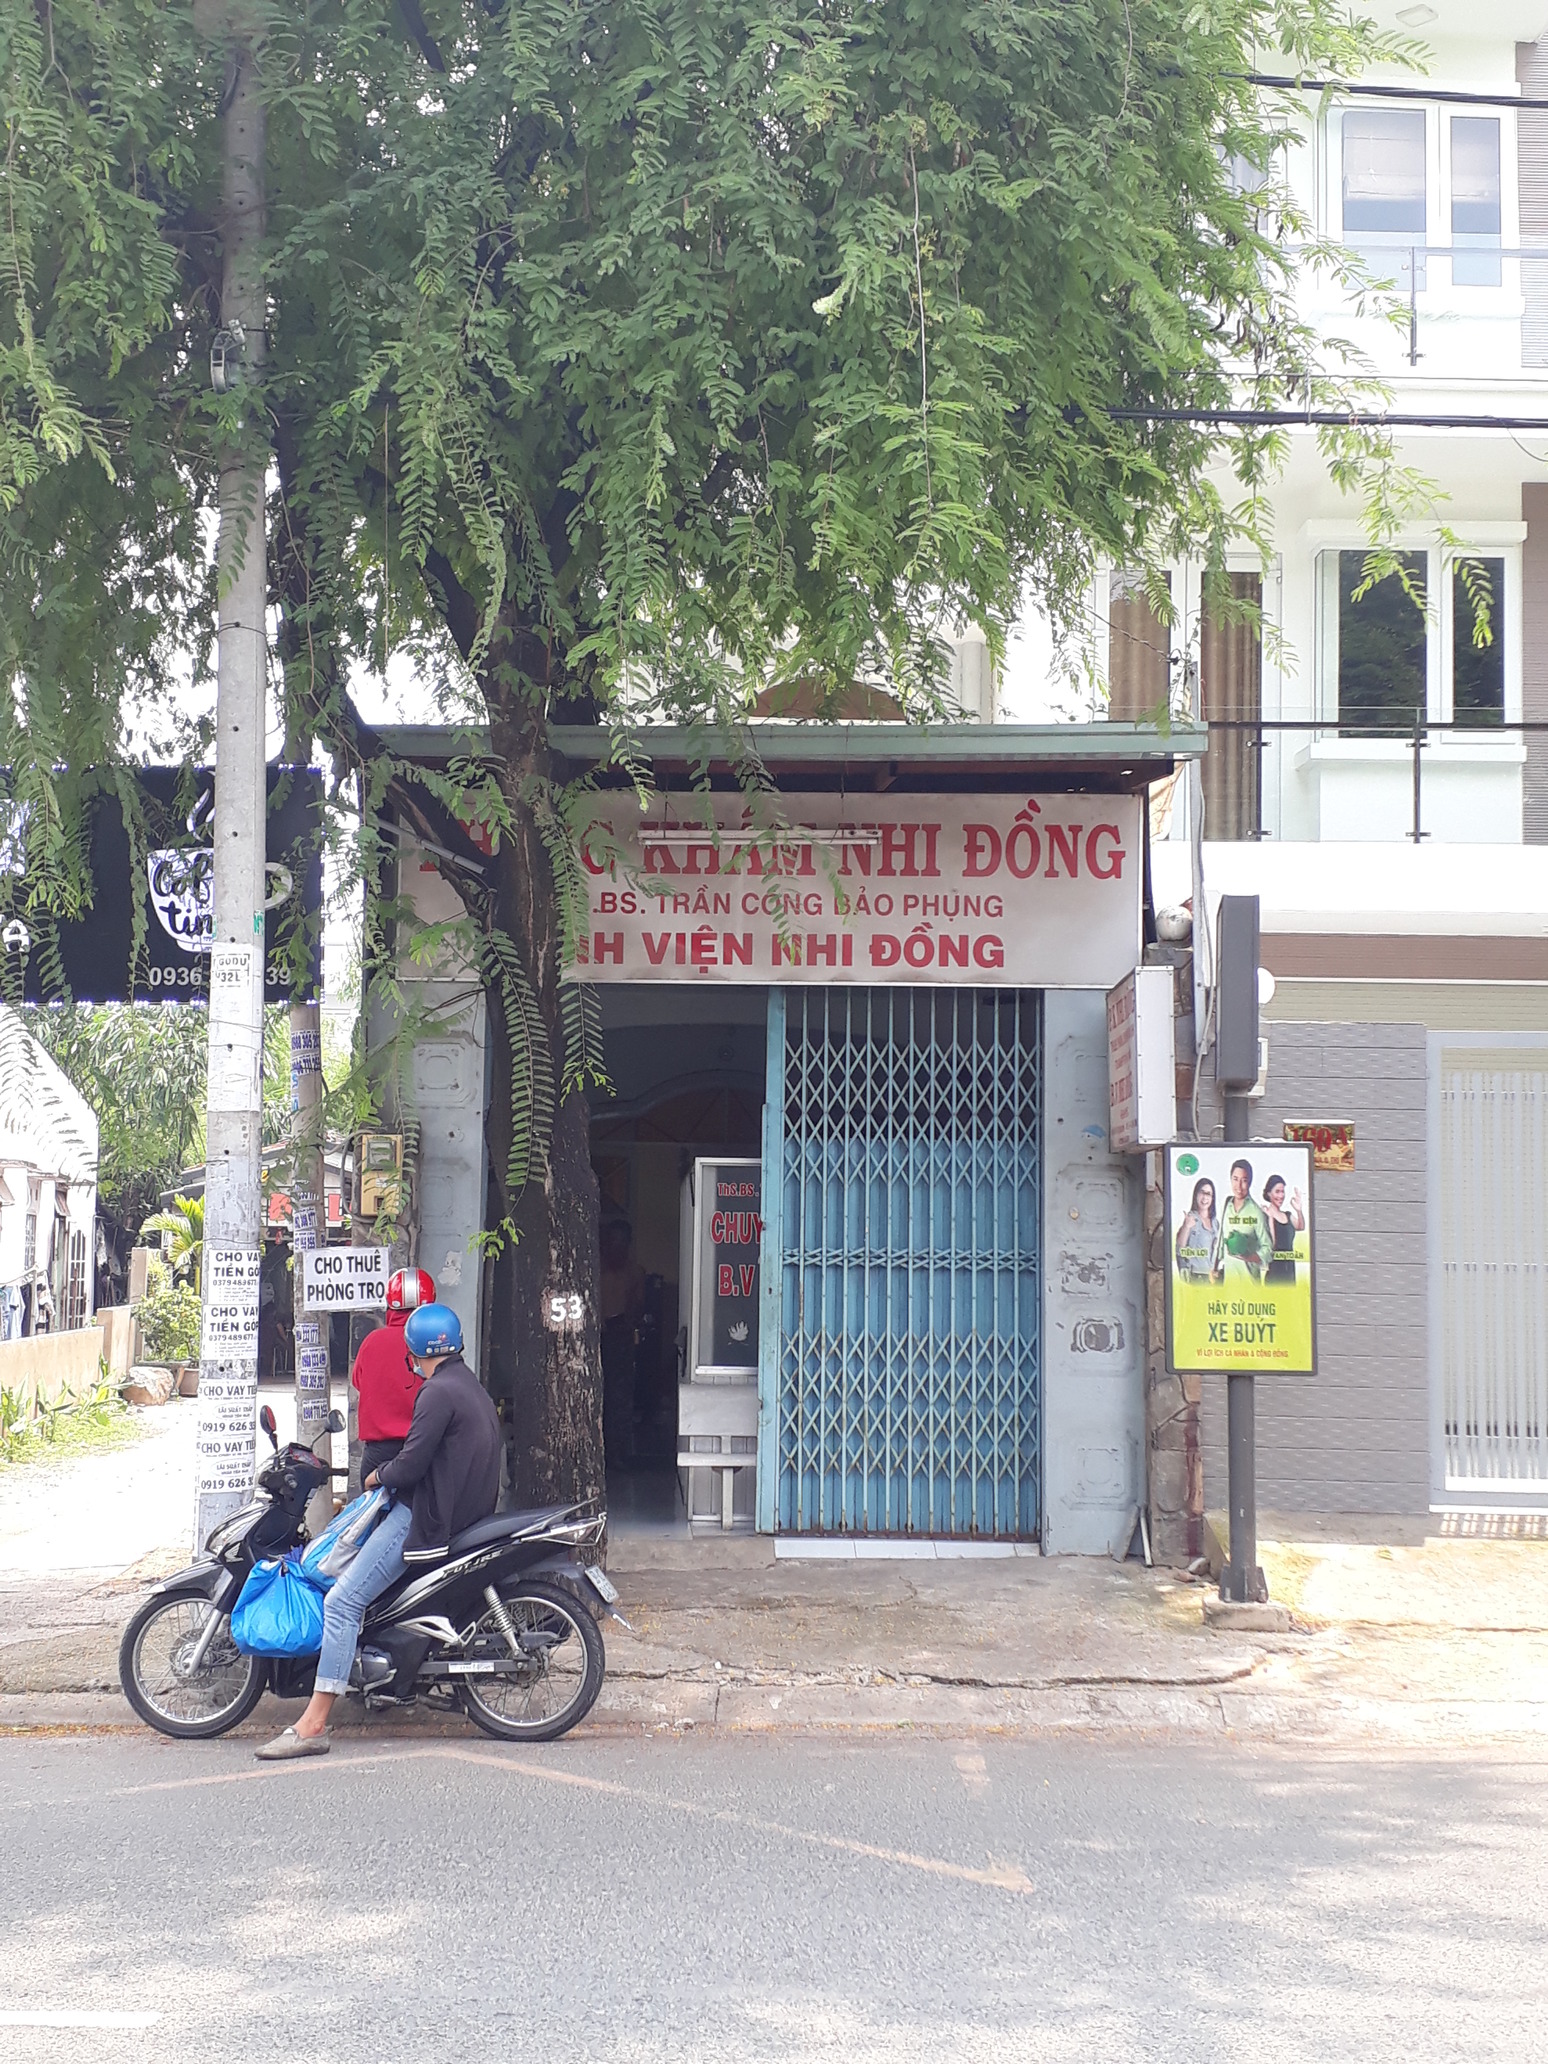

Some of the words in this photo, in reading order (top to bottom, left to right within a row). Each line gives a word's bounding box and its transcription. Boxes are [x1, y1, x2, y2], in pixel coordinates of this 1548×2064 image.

[837, 823, 942, 877] NHI
[962, 799, 1127, 880] ĐỒNG
[659, 884, 731, 914] TRẦN
[903, 894, 1004, 921] PHỤNG
[642, 924, 754, 974] VIỆN
[771, 933, 853, 967] NHI
[869, 922, 1005, 968] ĐỒNG
[215, 1252, 243, 1262] CHO
[314, 1256, 343, 1275] CHO
[346, 1249, 382, 1273] THUÊ
[247, 1264, 260, 1277] GÓ
[718, 1264, 755, 1297] B.V
[307, 1278, 354, 1302] PHÒNG
[358, 1281, 385, 1303] TRỌ
[211, 1307, 238, 1318] CHO
[550, 1294, 584, 1323] 53
[1208, 1299, 1228, 1316] HÃY
[1247, 1302, 1276, 1319] DỤNG
[1208, 1322, 1228, 1343] XE
[1234, 1317, 1276, 1343] BUÝT
[203, 1386, 224, 1397] CHO
[227, 1385, 246, 1396] VAY
[203, 1422, 226, 1432] 0919
[229, 1421, 247, 1431] 626
[201, 1443, 221, 1454] CHO
[224, 1441, 243, 1453] VAY
[201, 1479, 225, 1490] 0919
[228, 1478, 246, 1489] 626
